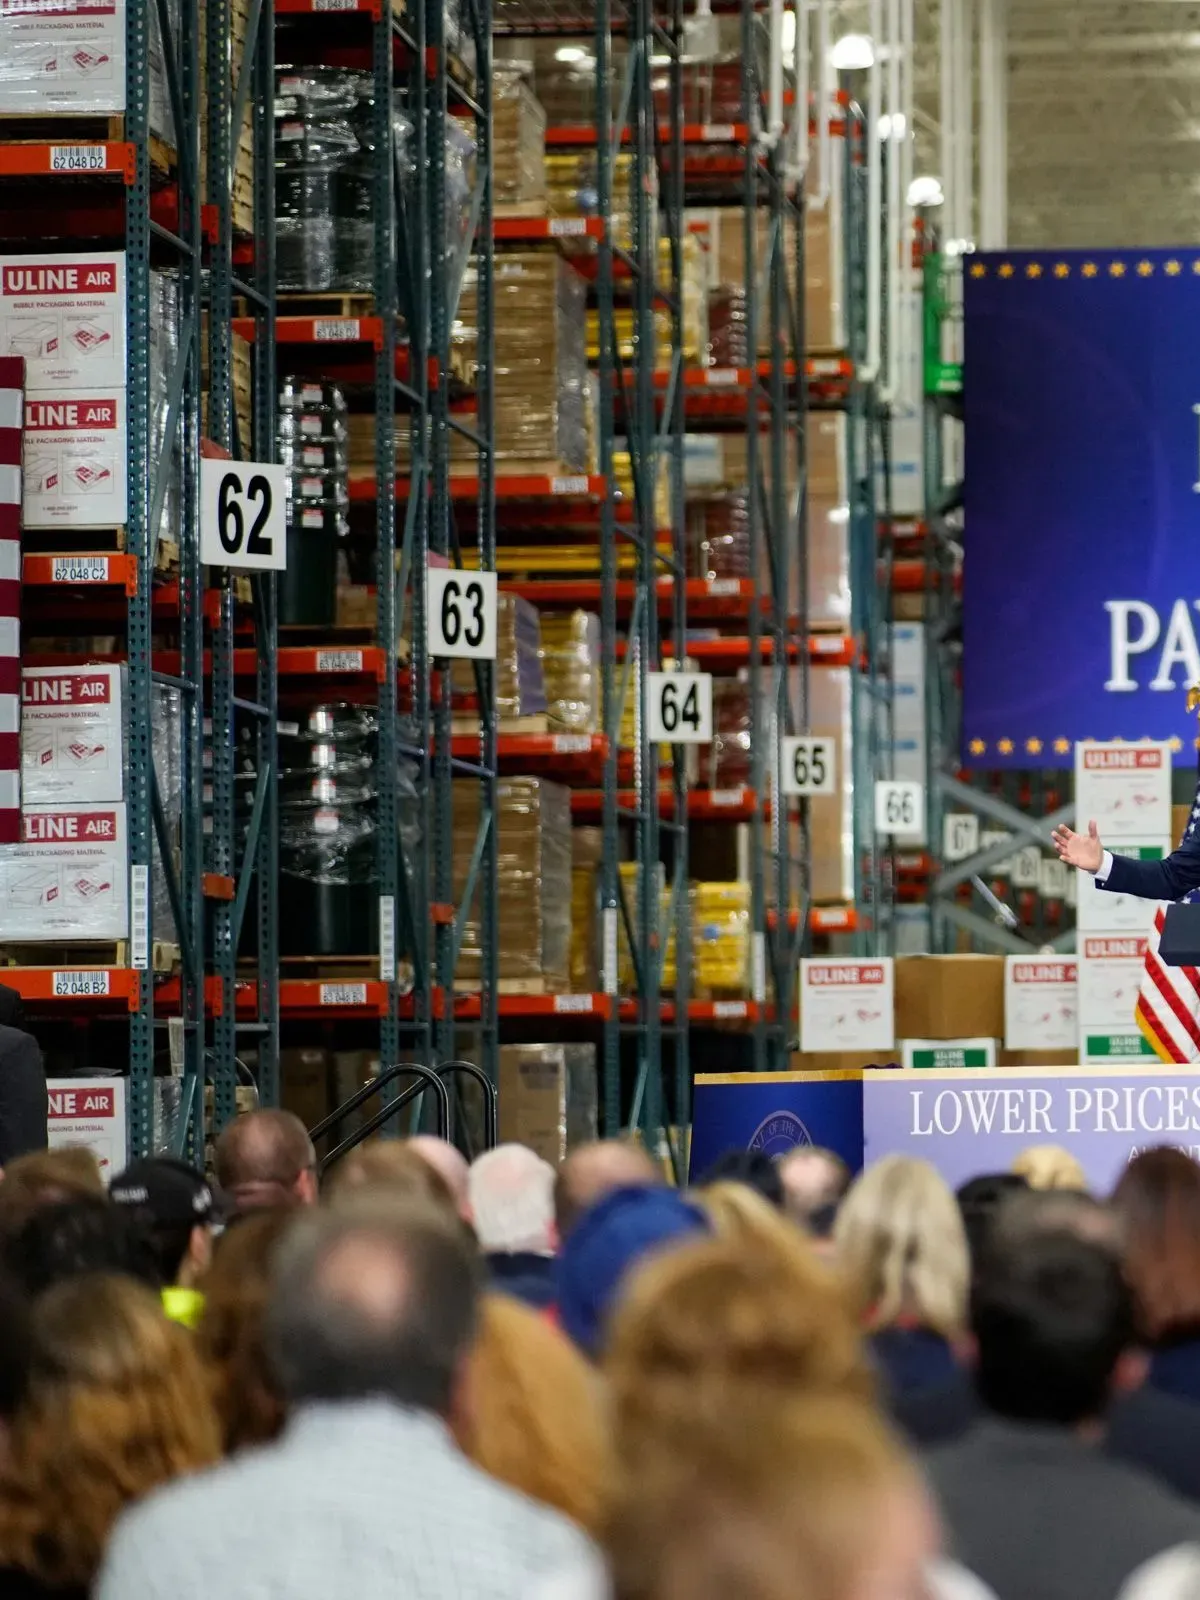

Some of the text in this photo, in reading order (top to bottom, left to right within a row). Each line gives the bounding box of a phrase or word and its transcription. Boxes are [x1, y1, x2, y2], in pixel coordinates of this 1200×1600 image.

[53, 156, 103, 169] 62 048 D2
[8, 269, 111, 291] ULINE AIR
[26, 405, 111, 427] LINE AIR
[217, 472, 273, 556] 62
[55, 567, 106, 580] 62 048 C2
[441, 581, 485, 647] 63
[22, 680, 105, 702] LINE AIR
[661, 683, 700, 732] 64
[794, 746, 826, 786] 65
[1086, 750, 1136, 768] ULINE
[887, 791, 914, 824] 66
[26, 817, 112, 838] LINE AIR
[1087, 939, 1137, 957] ULINE
[811, 967, 857, 985] ULINE
[1014, 964, 1064, 981] ULINE
[56, 981, 106, 995] 62 048 B2
[84, 1096, 109, 1110] AIR
[910, 1089, 1057, 1135] LOWER
[768, 1120, 796, 1137] OF THE
